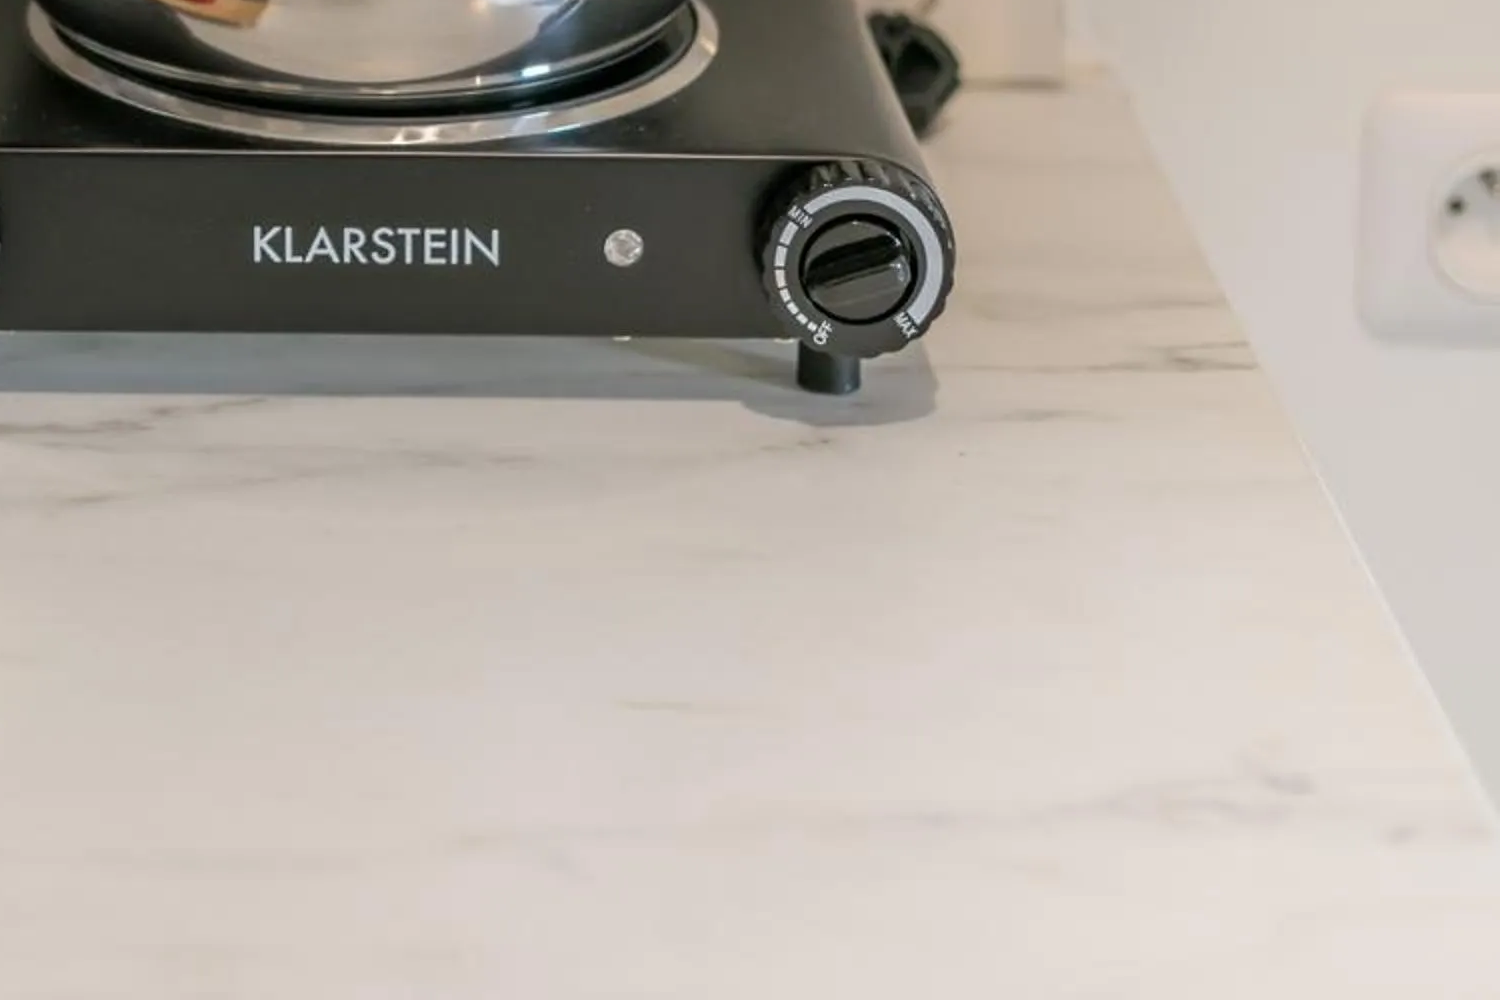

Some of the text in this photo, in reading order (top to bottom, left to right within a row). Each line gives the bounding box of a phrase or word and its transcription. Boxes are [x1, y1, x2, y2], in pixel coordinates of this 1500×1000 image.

[787, 205, 814, 229] MIN
[252, 225, 500, 267] KLARSTEIN
[893, 311, 919, 339] MAX
